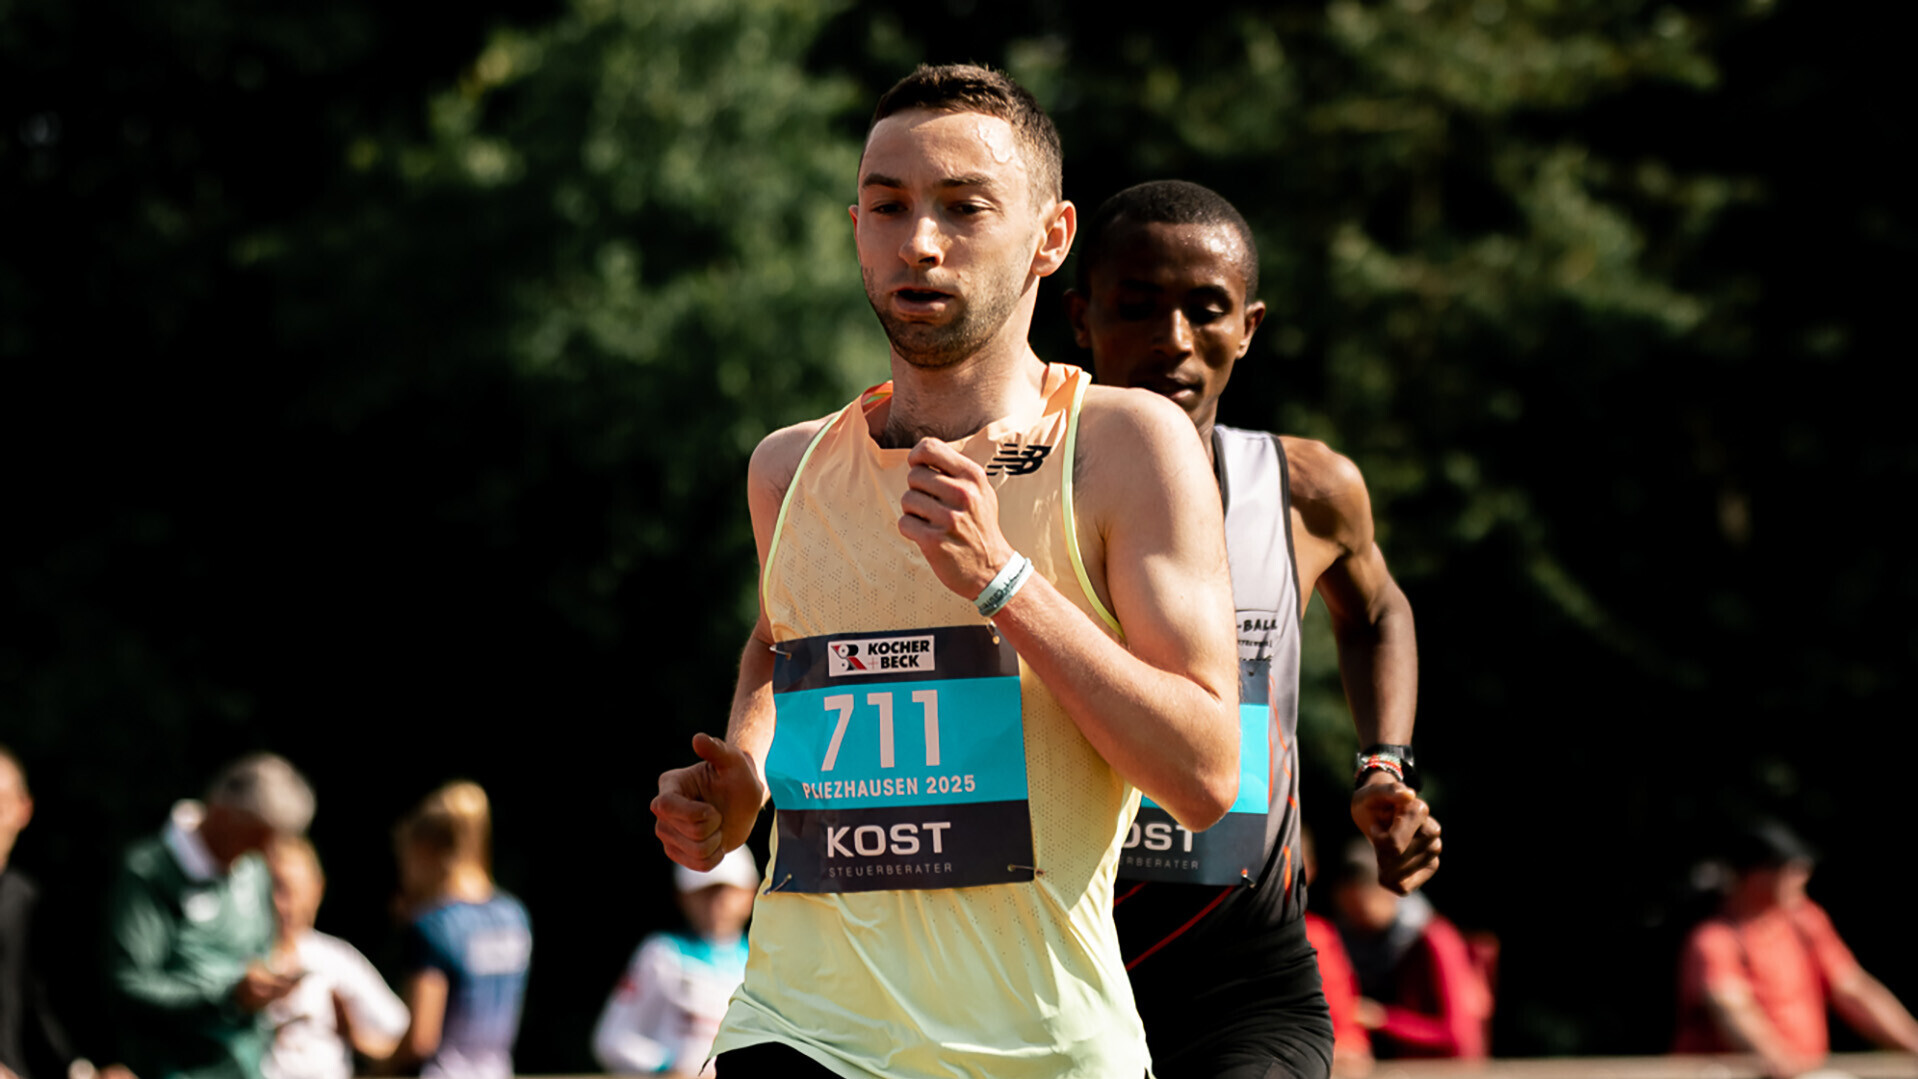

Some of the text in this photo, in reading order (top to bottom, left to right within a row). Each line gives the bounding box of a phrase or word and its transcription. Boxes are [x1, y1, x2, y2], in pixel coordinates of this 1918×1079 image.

[867, 640, 930, 656] KOCHER
[880, 654, 920, 670] BECK
[821, 689, 941, 772] 711
[802, 774, 977, 800] PLIEZHAUSEN 2025
[827, 822, 952, 858] KOST
[829, 861, 953, 879] STEUERBERATER
